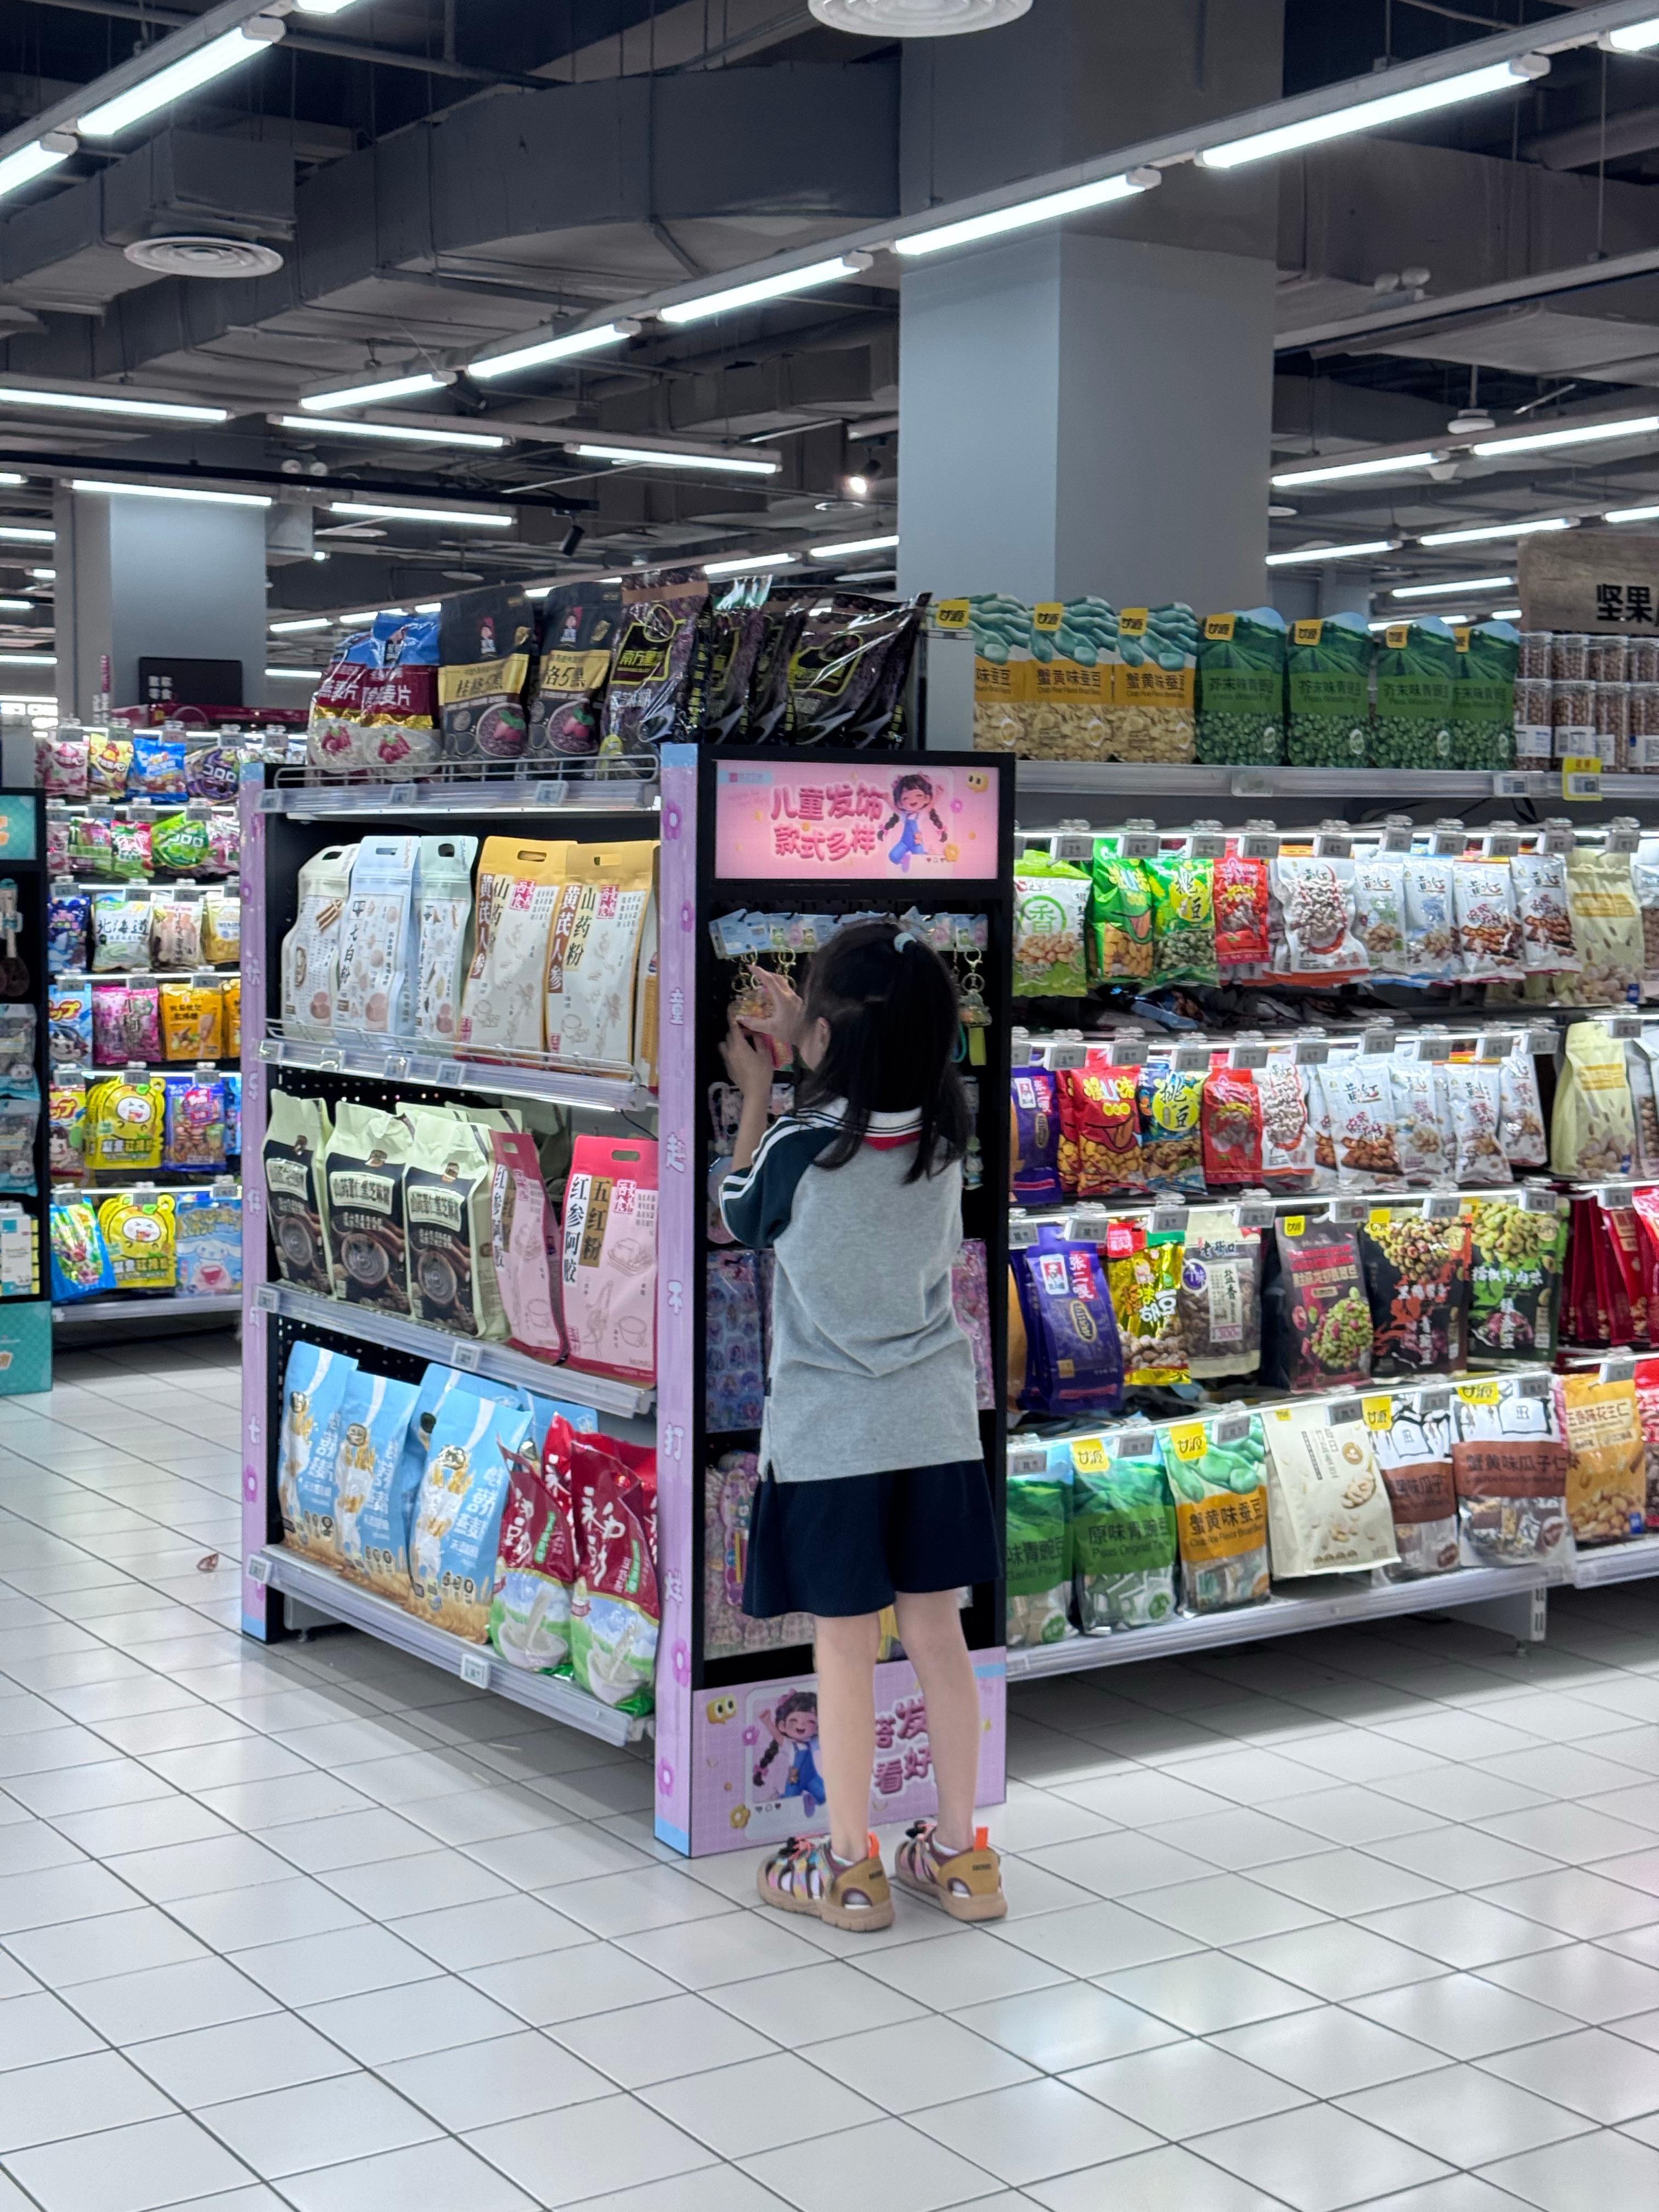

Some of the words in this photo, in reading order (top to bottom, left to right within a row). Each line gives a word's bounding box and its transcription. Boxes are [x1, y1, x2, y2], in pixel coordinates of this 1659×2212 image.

[1597, 583, 1659, 623] 坚果
[770, 782, 884, 821] 儿童发饰
[773, 823, 877, 861] 款式多样
[97, 918, 150, 935] 北海道
[549, 885, 582, 990] 黄芪人参
[566, 888, 596, 966] 山药粉
[1024, 903, 1057, 934] 香
[563, 1176, 588, 1284] 红参阿胶
[583, 1180, 611, 1262] 五红粉
[1189, 1498, 1263, 1537] 蟹黄味蚕豆
